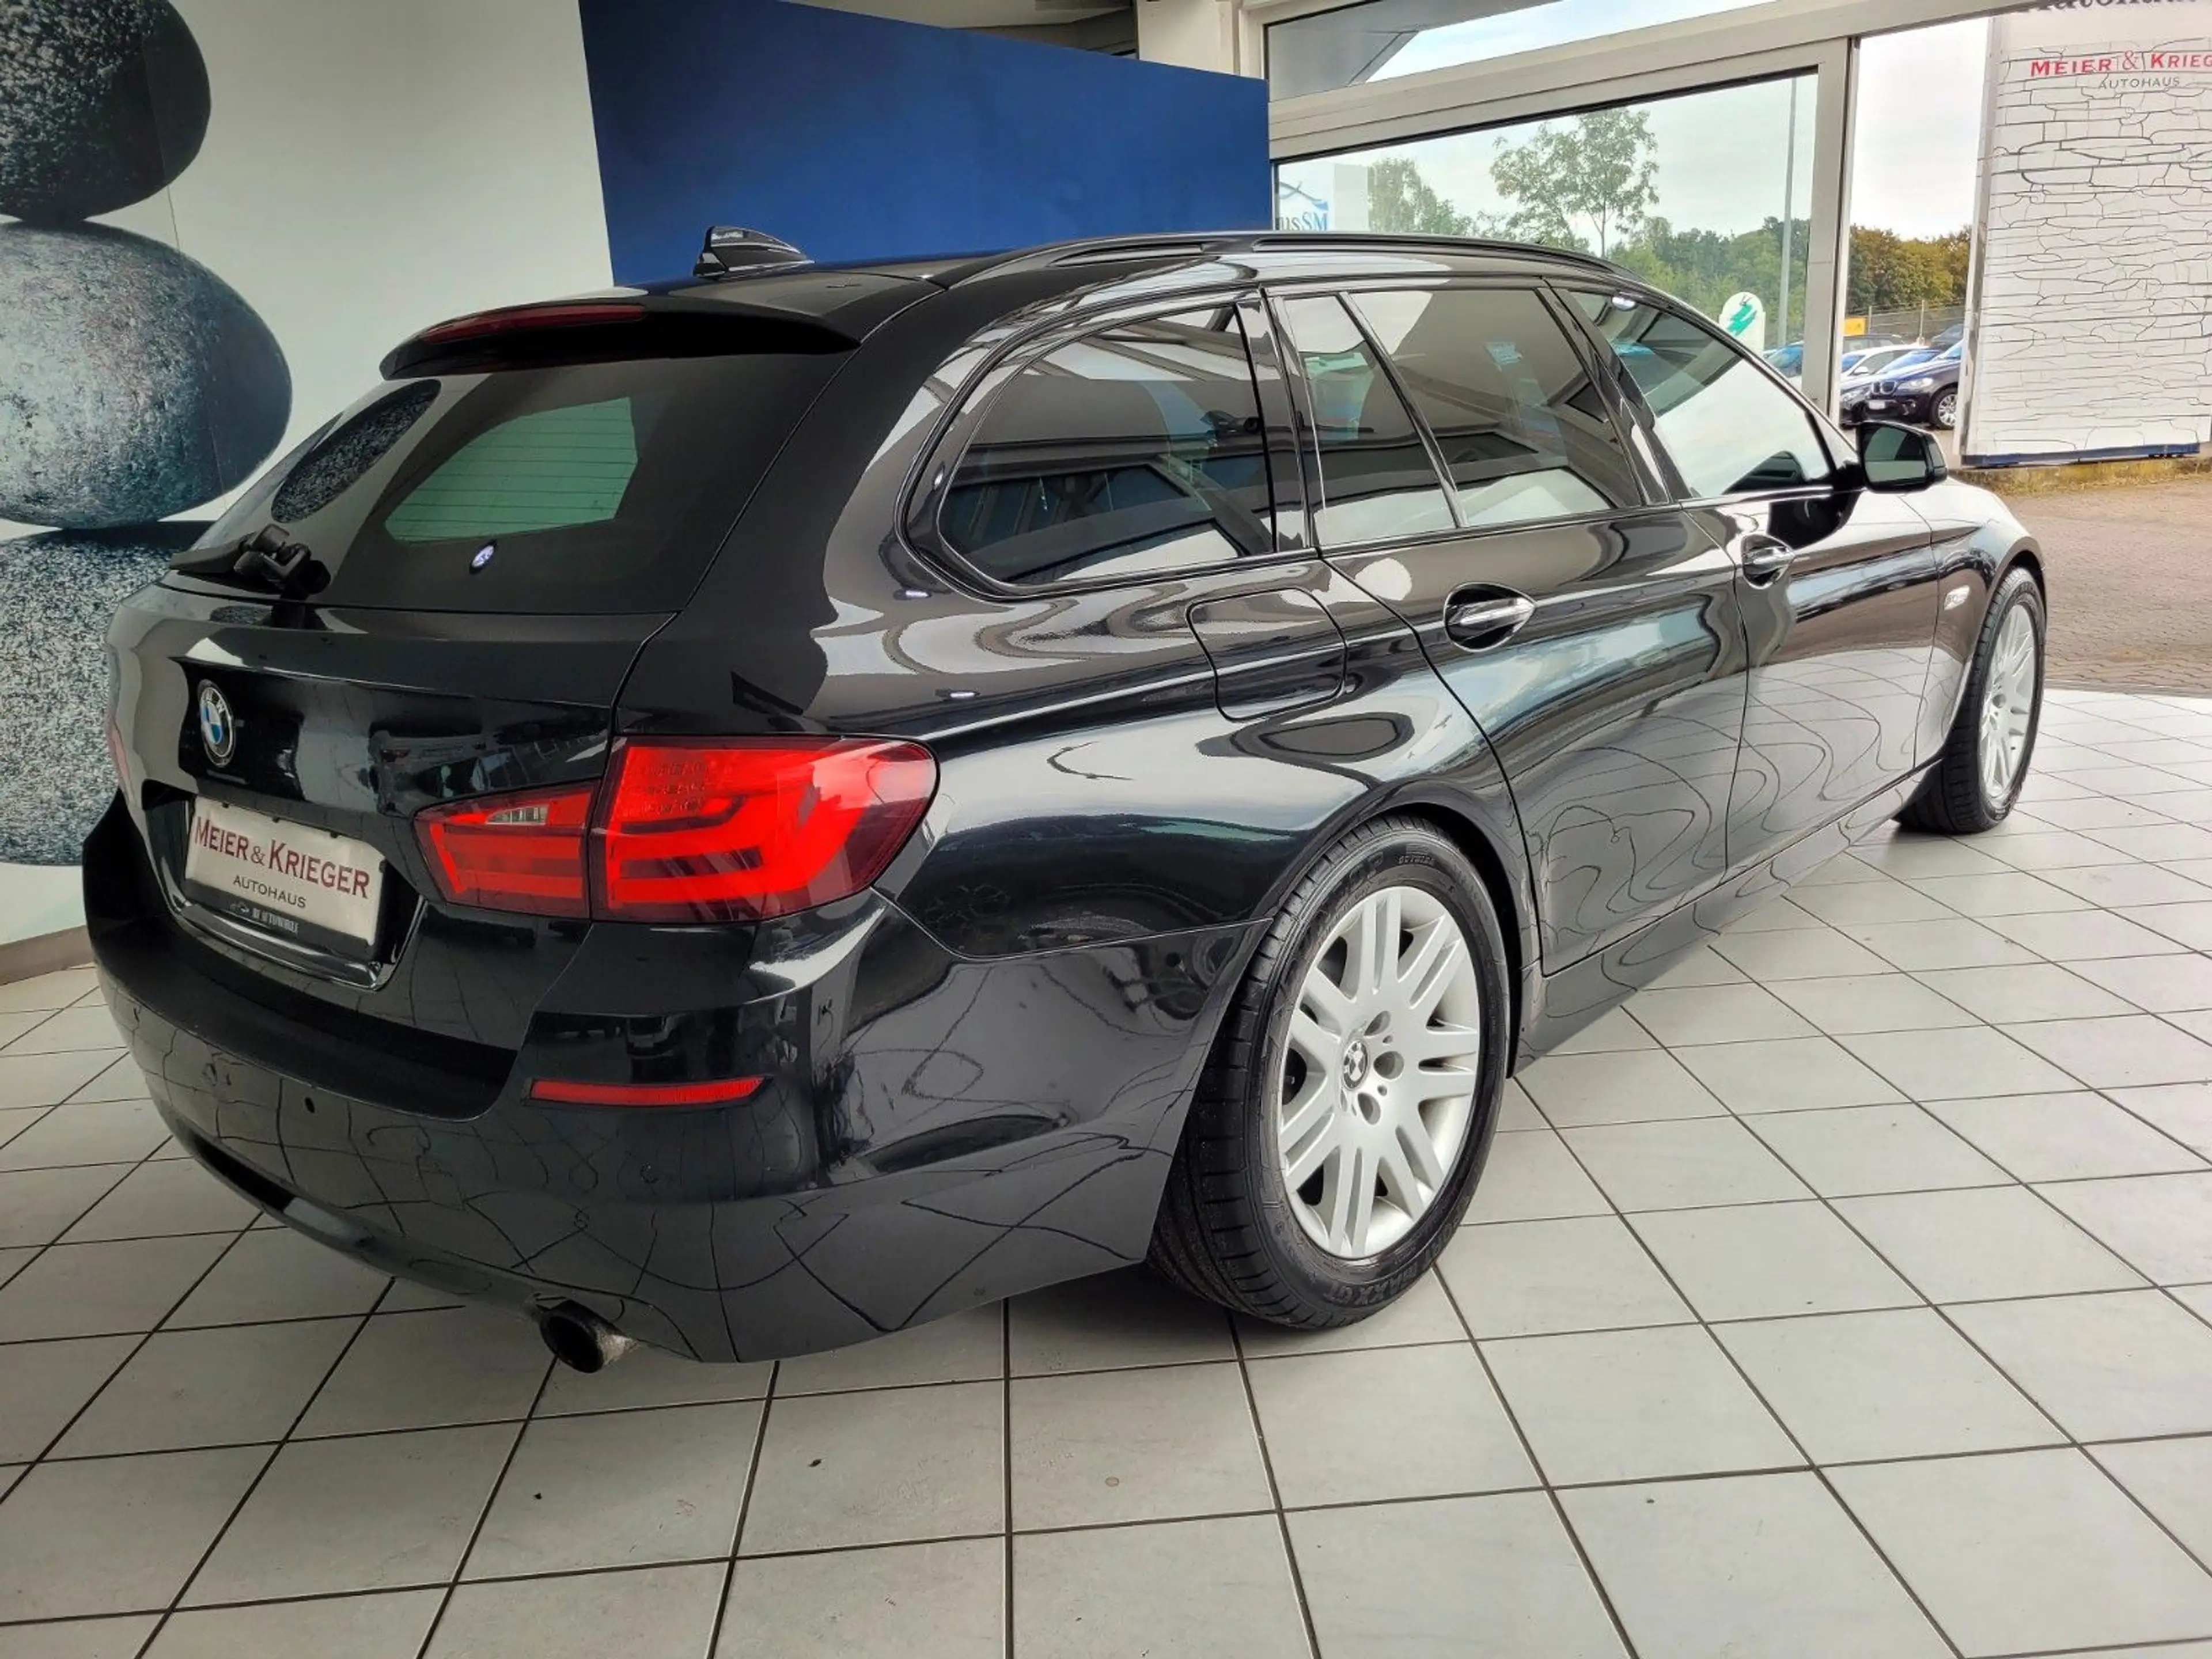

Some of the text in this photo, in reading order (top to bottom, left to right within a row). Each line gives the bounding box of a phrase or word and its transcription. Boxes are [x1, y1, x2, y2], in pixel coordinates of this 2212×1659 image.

[2031, 58, 2112, 77] MEIER
[2122, 50, 2142, 70] &
[2100, 77, 2181, 89] AUTOHAUS
[194, 816, 371, 899] MEIER & KRIEGER
[232, 874, 308, 909] AUTOHAUS
